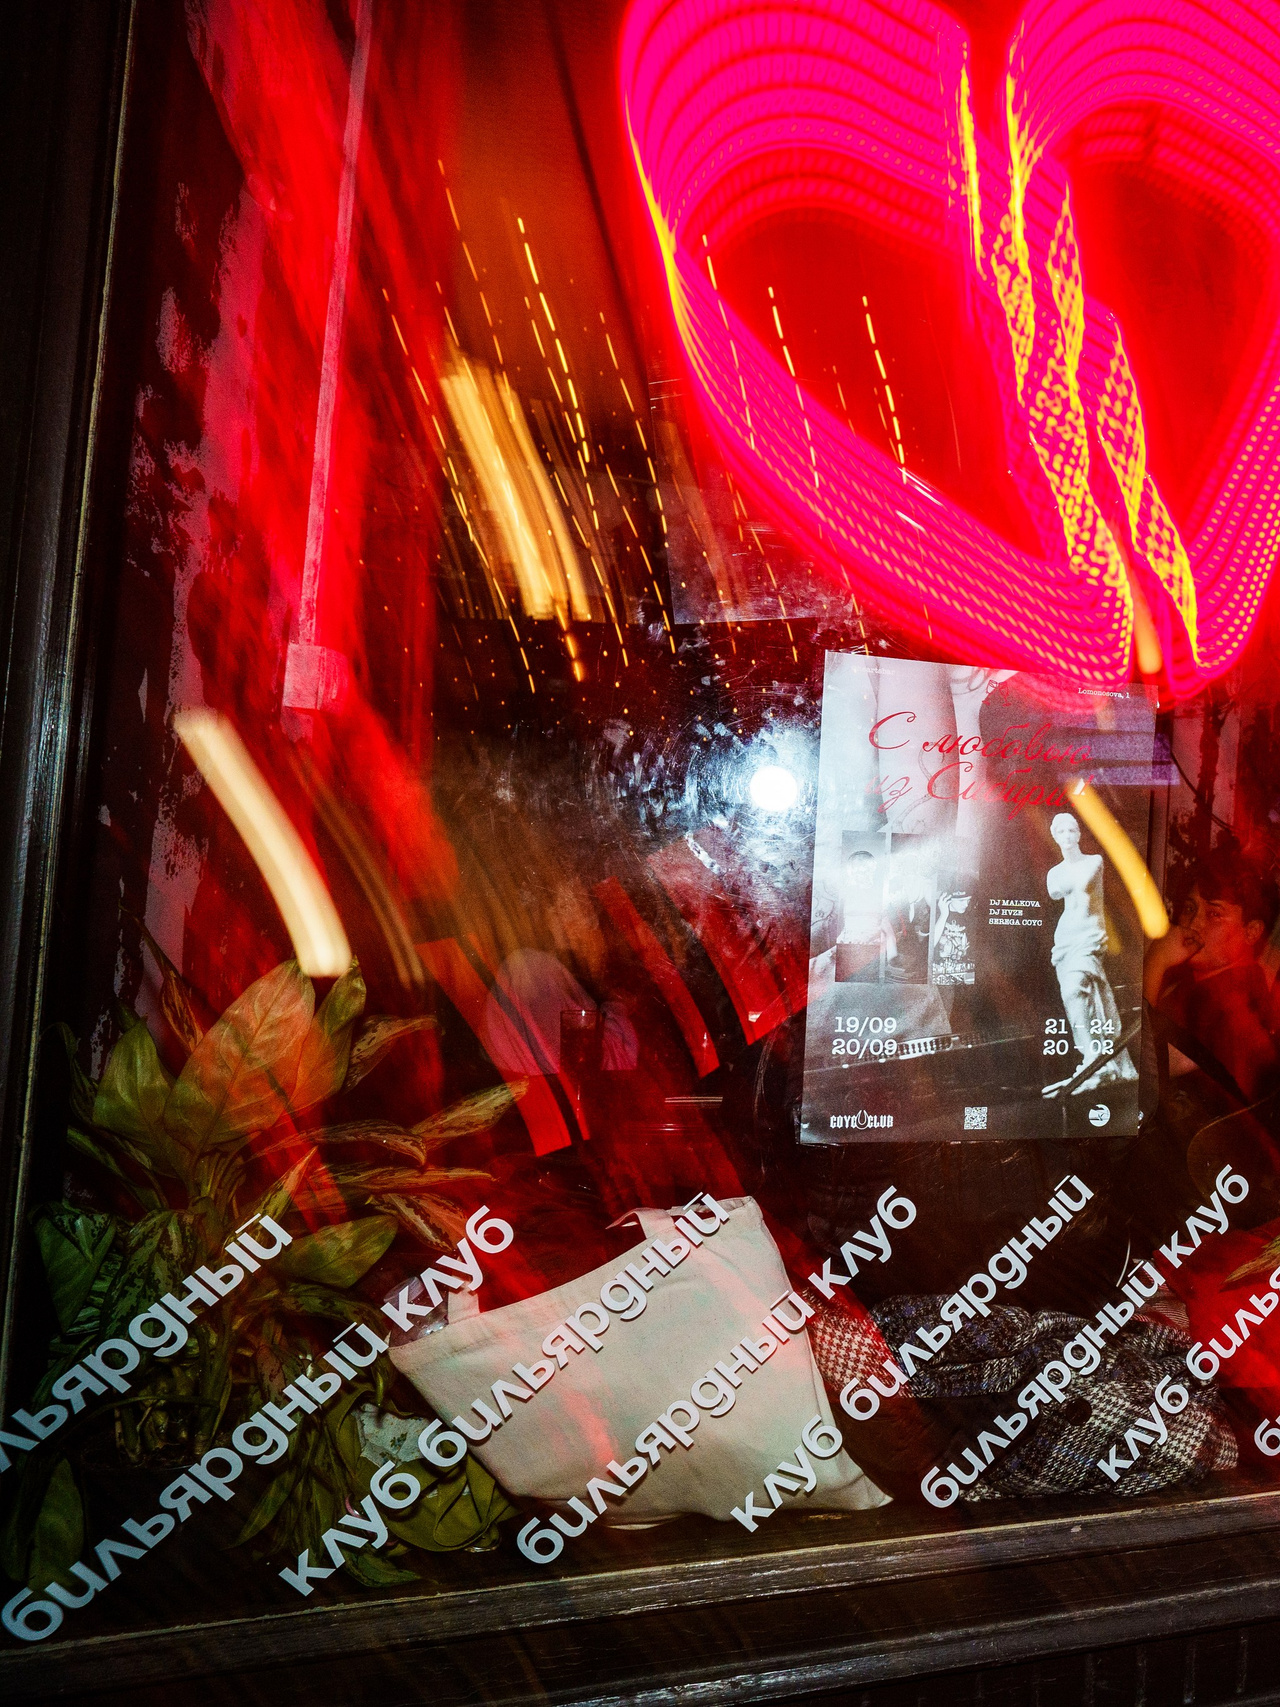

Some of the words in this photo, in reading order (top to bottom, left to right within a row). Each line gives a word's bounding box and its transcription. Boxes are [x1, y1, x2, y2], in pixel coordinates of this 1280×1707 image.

[1078, 688, 1124, 698] Lomonosova,
[868, 711, 917, 750] С
[922, 722, 1093, 764] любовью
[865, 775, 913, 813] из
[926, 761, 1095, 820] Сибири!
[989, 908, 1000, 916] DJ
[1002, 900, 1041, 908] MALKOVA
[831, 1038, 898, 1059] 20/09
[833, 1016, 898, 1037] 19/09
[1042, 1039, 1069, 1056] 20
[1089, 1039, 1114, 1055] 02
[1044, 1018, 1068, 1035] 21
[1089, 1018, 1115, 1035] 24
[729, 1414, 842, 1533] клуб
[838, 1174, 1095, 1422] бильярдный
[920, 1258, 1165, 1509] бильярдный
[1158, 1163, 1251, 1269] клуб
[278, 1460, 421, 1596] клуб
[417, 1191, 731, 1468] бильярдный
[516, 1289, 815, 1564] бильярдный
[807, 1185, 917, 1300] клуб
[2, 1321, 389, 1641] бильярдный
[380, 1204, 515, 1332] клуб
[1096, 1375, 1189, 1483] клуб
